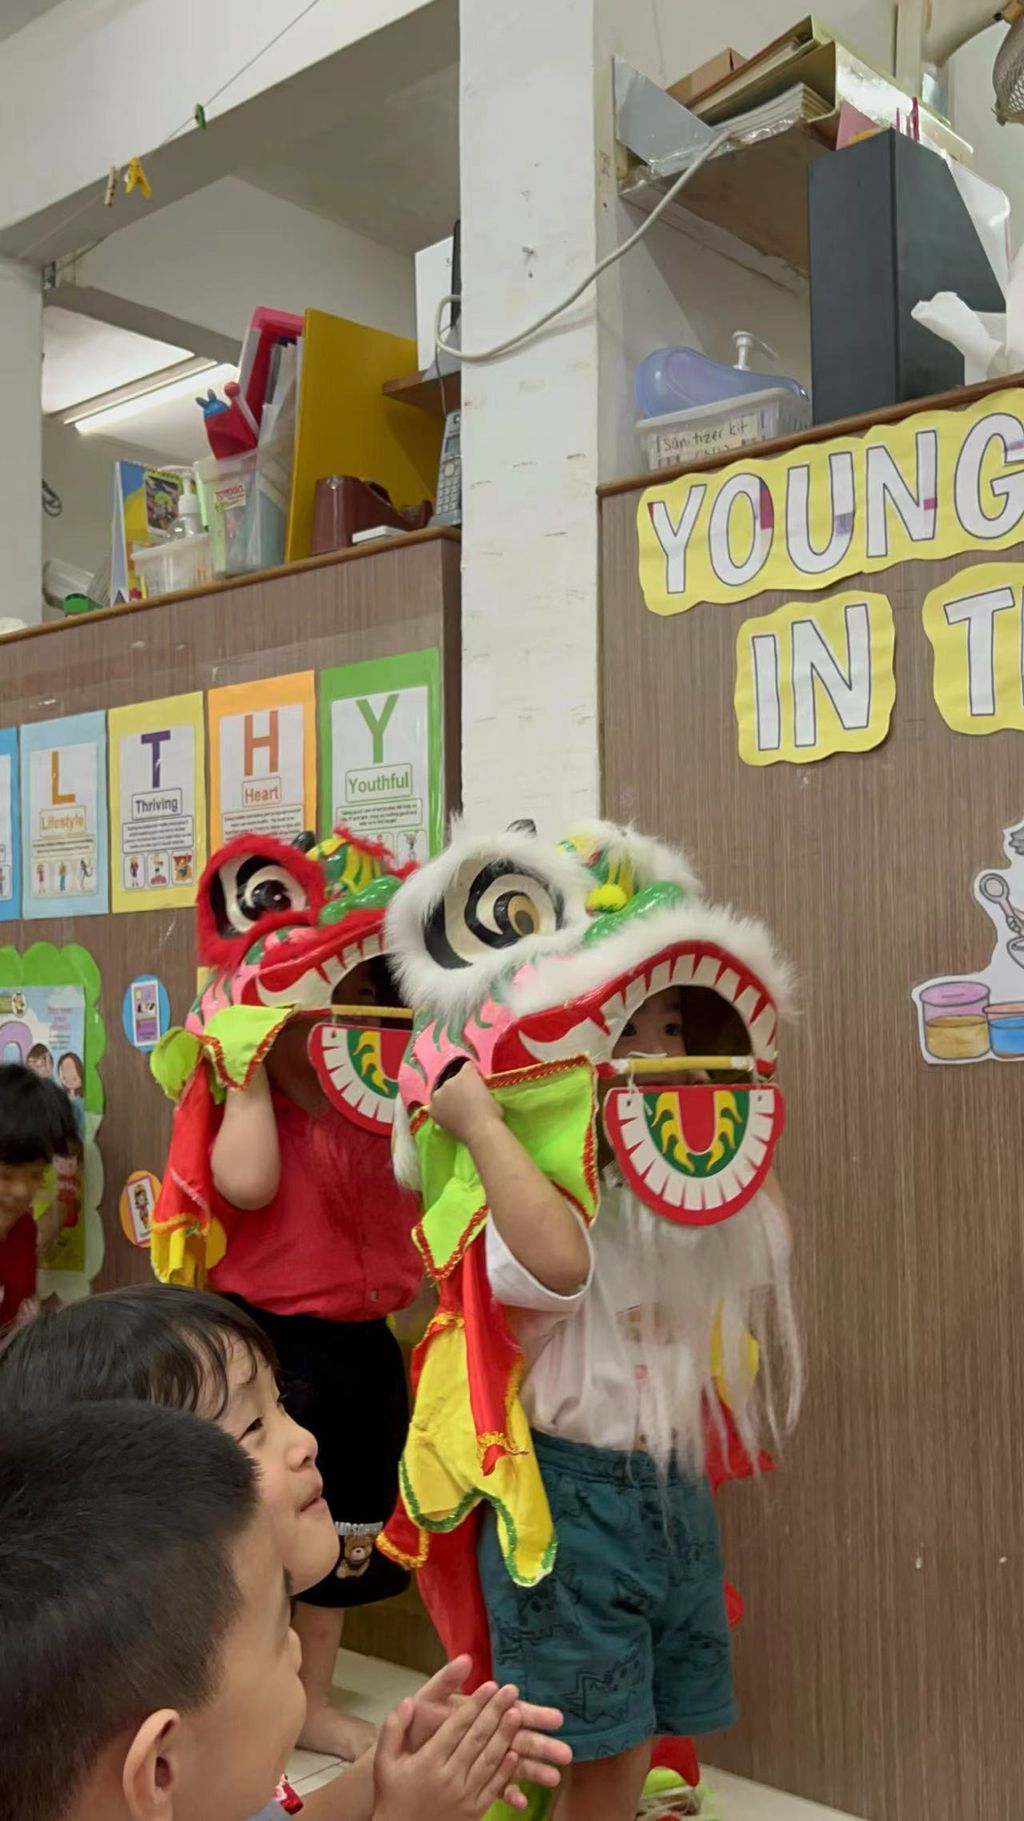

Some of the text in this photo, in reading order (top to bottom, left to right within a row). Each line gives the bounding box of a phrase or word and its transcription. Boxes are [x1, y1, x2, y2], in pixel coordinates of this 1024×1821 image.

[647, 412, 1024, 593] YOUNG
[751, 587, 1024, 751] IN T
[243, 709, 279, 777] H
[354, 693, 400, 765] Y
[51, 750, 76, 806] L
[140, 729, 171, 789] T
[348, 771, 410, 795] Youthful
[41, 813, 85, 831] Lifestyle
[135, 797, 178, 814] Thriving
[244, 785, 279, 804] Heart
